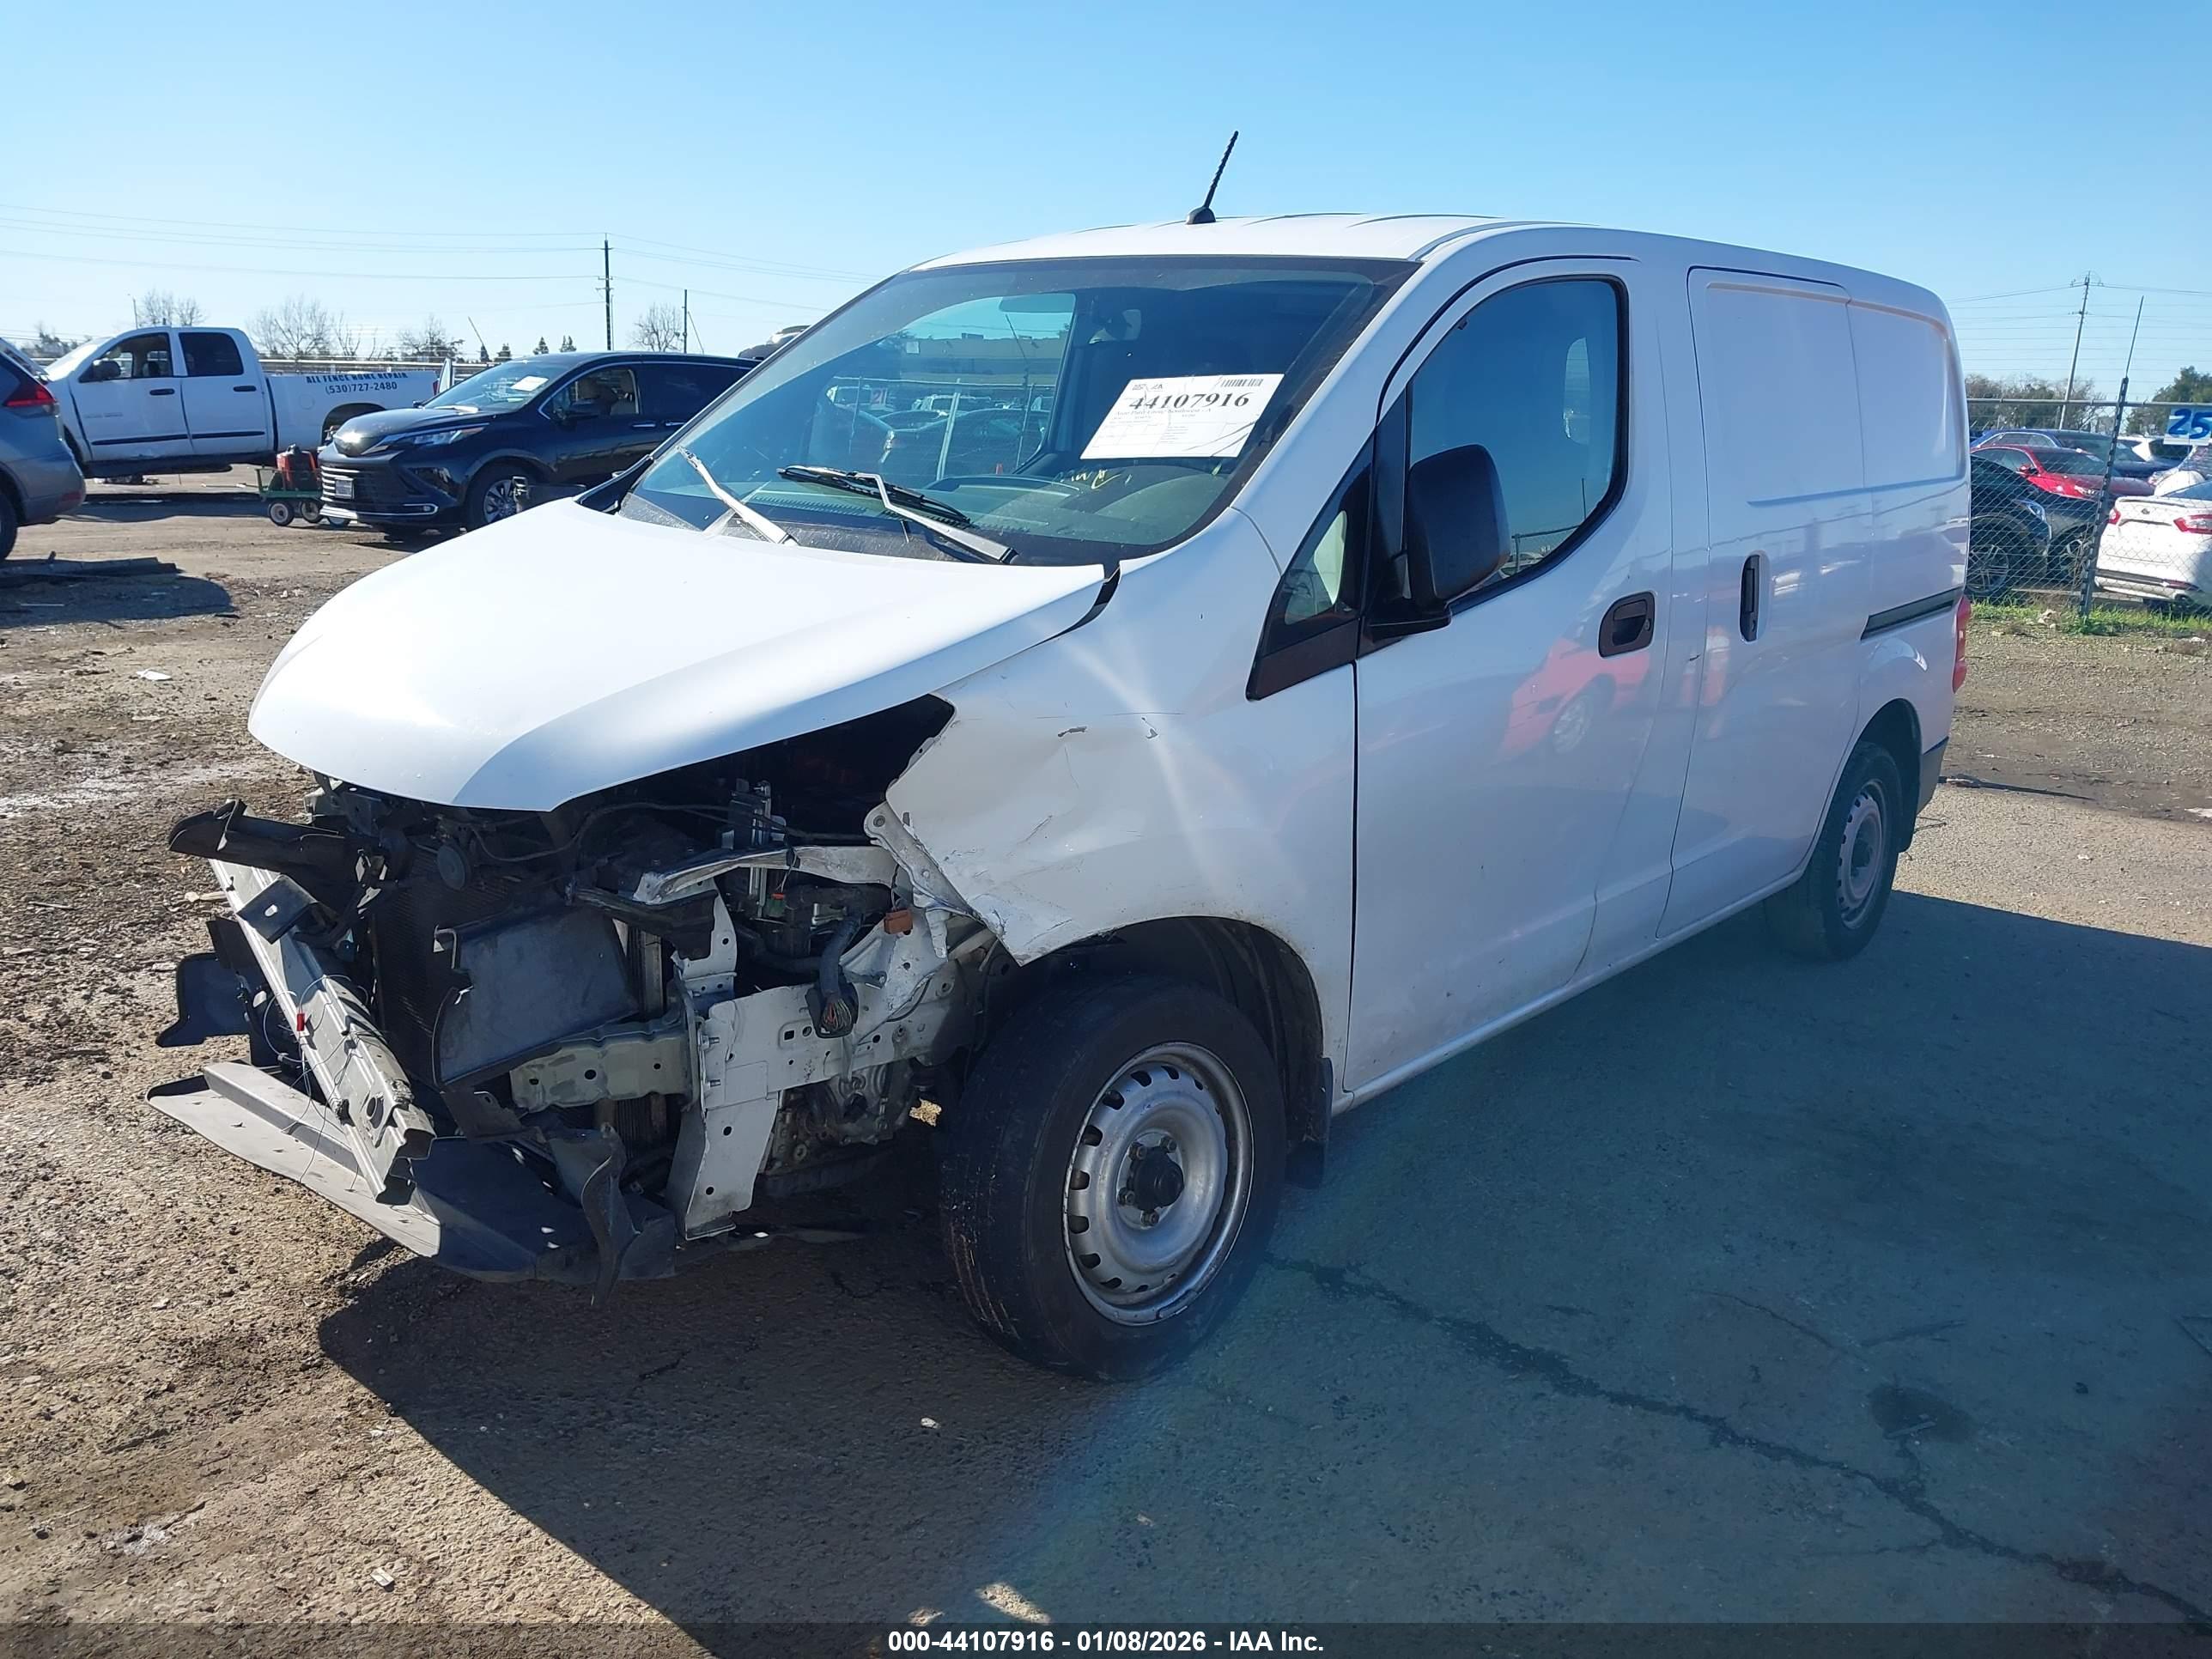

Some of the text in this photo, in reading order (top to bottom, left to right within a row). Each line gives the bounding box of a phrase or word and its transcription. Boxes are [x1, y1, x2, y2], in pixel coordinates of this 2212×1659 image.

[325, 381, 398, 395] (530)727-2480
[1129, 392, 1255, 410] 44107916
[2168, 409, 2212, 439] 25
